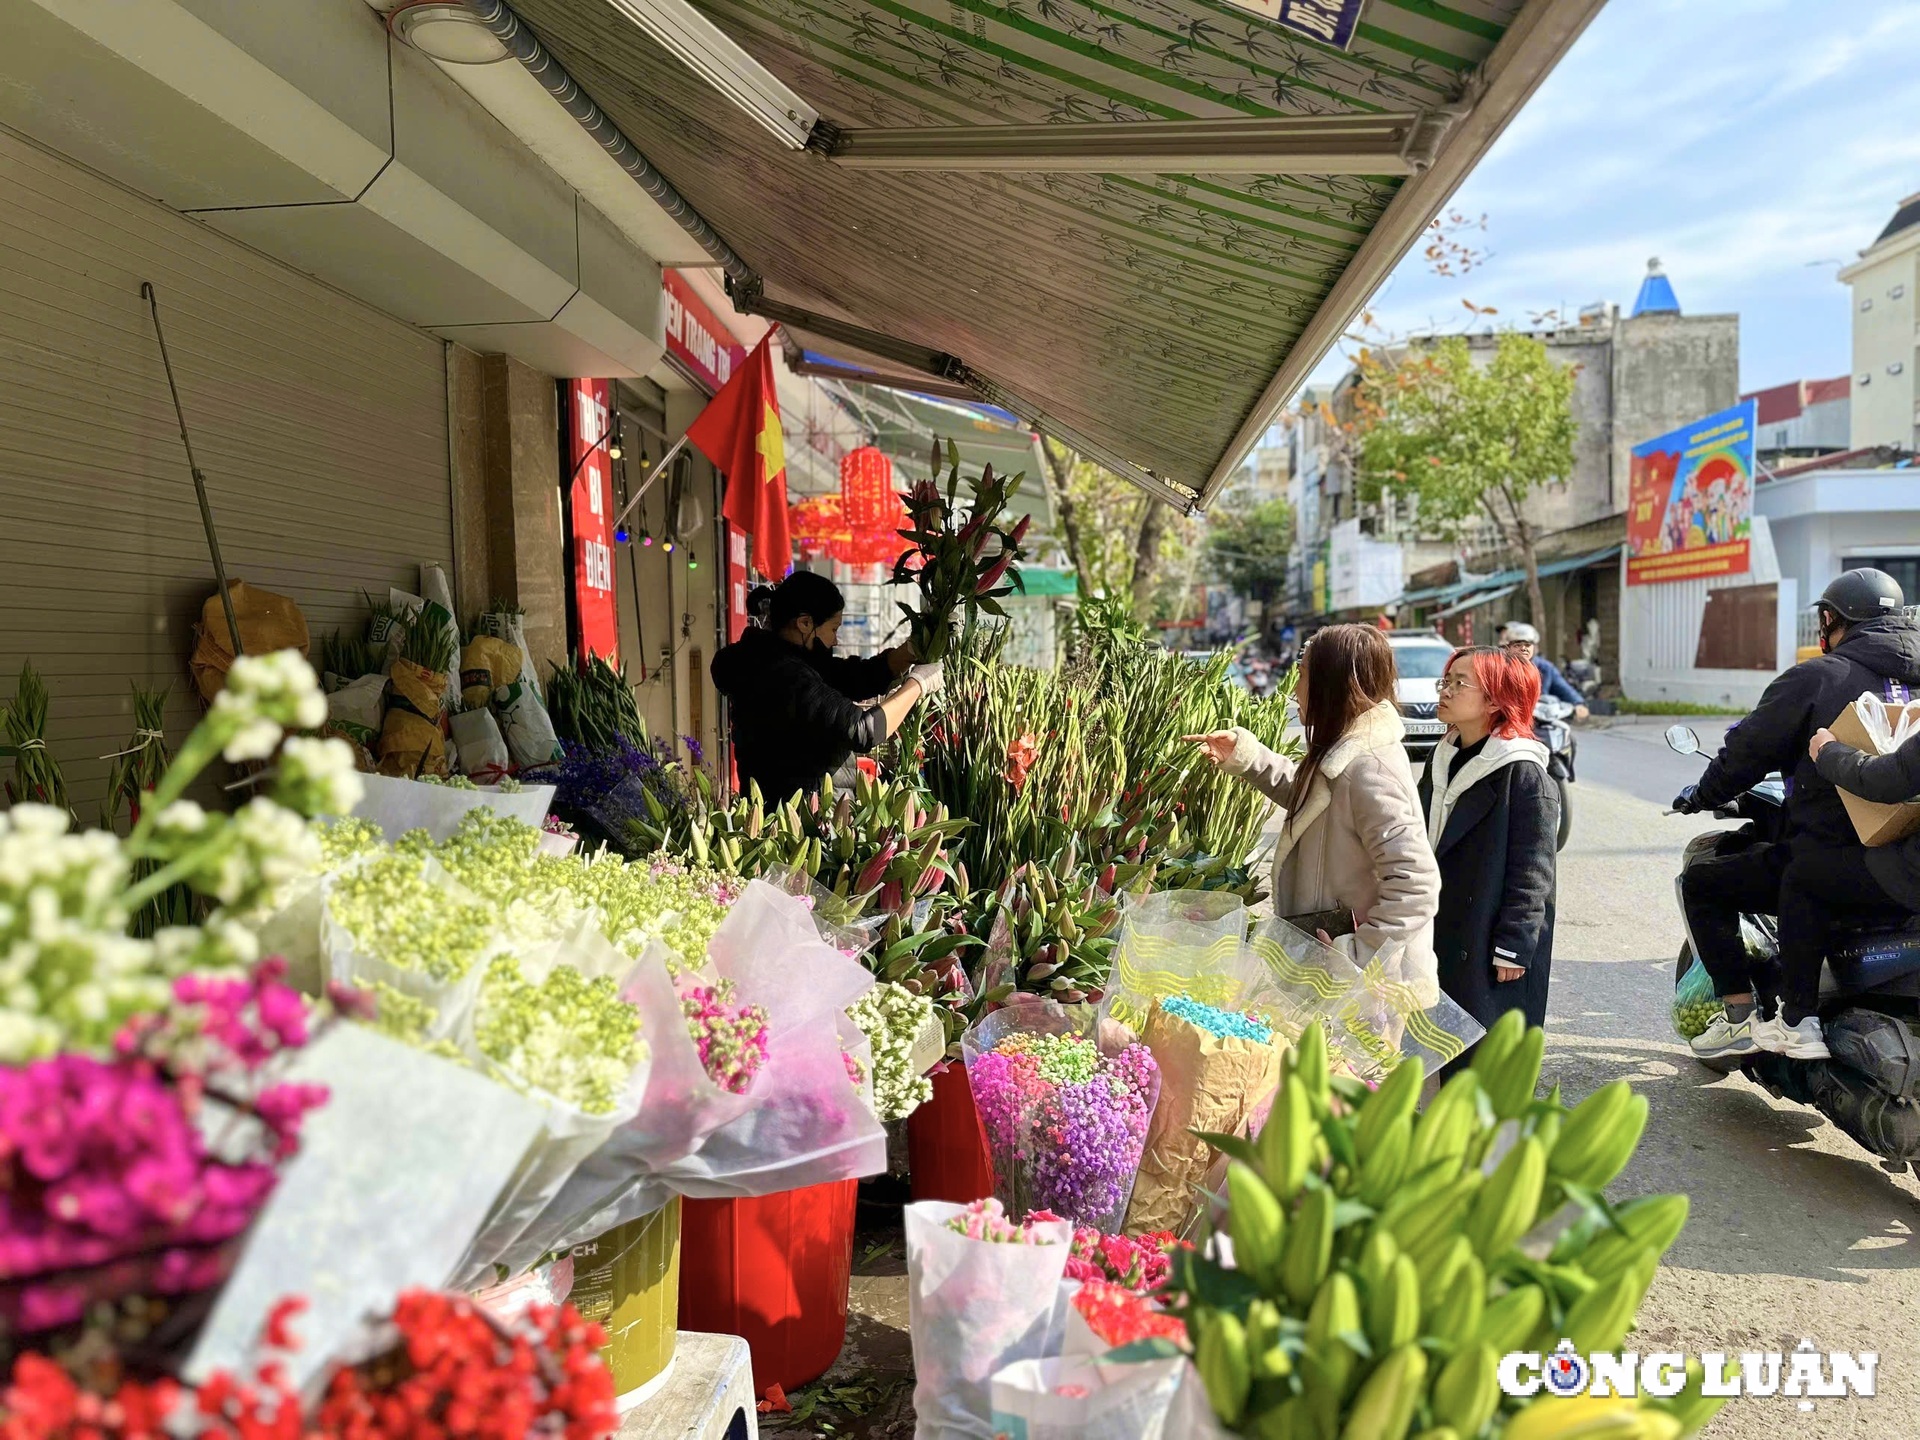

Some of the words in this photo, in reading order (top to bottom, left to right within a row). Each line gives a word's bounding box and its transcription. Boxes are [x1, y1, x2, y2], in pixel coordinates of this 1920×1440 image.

[685, 309, 716, 375] TRANG
[577, 389, 607, 453] THIẾT
[588, 465, 604, 525] BỊ
[585, 534, 612, 599] ĐIỆN
